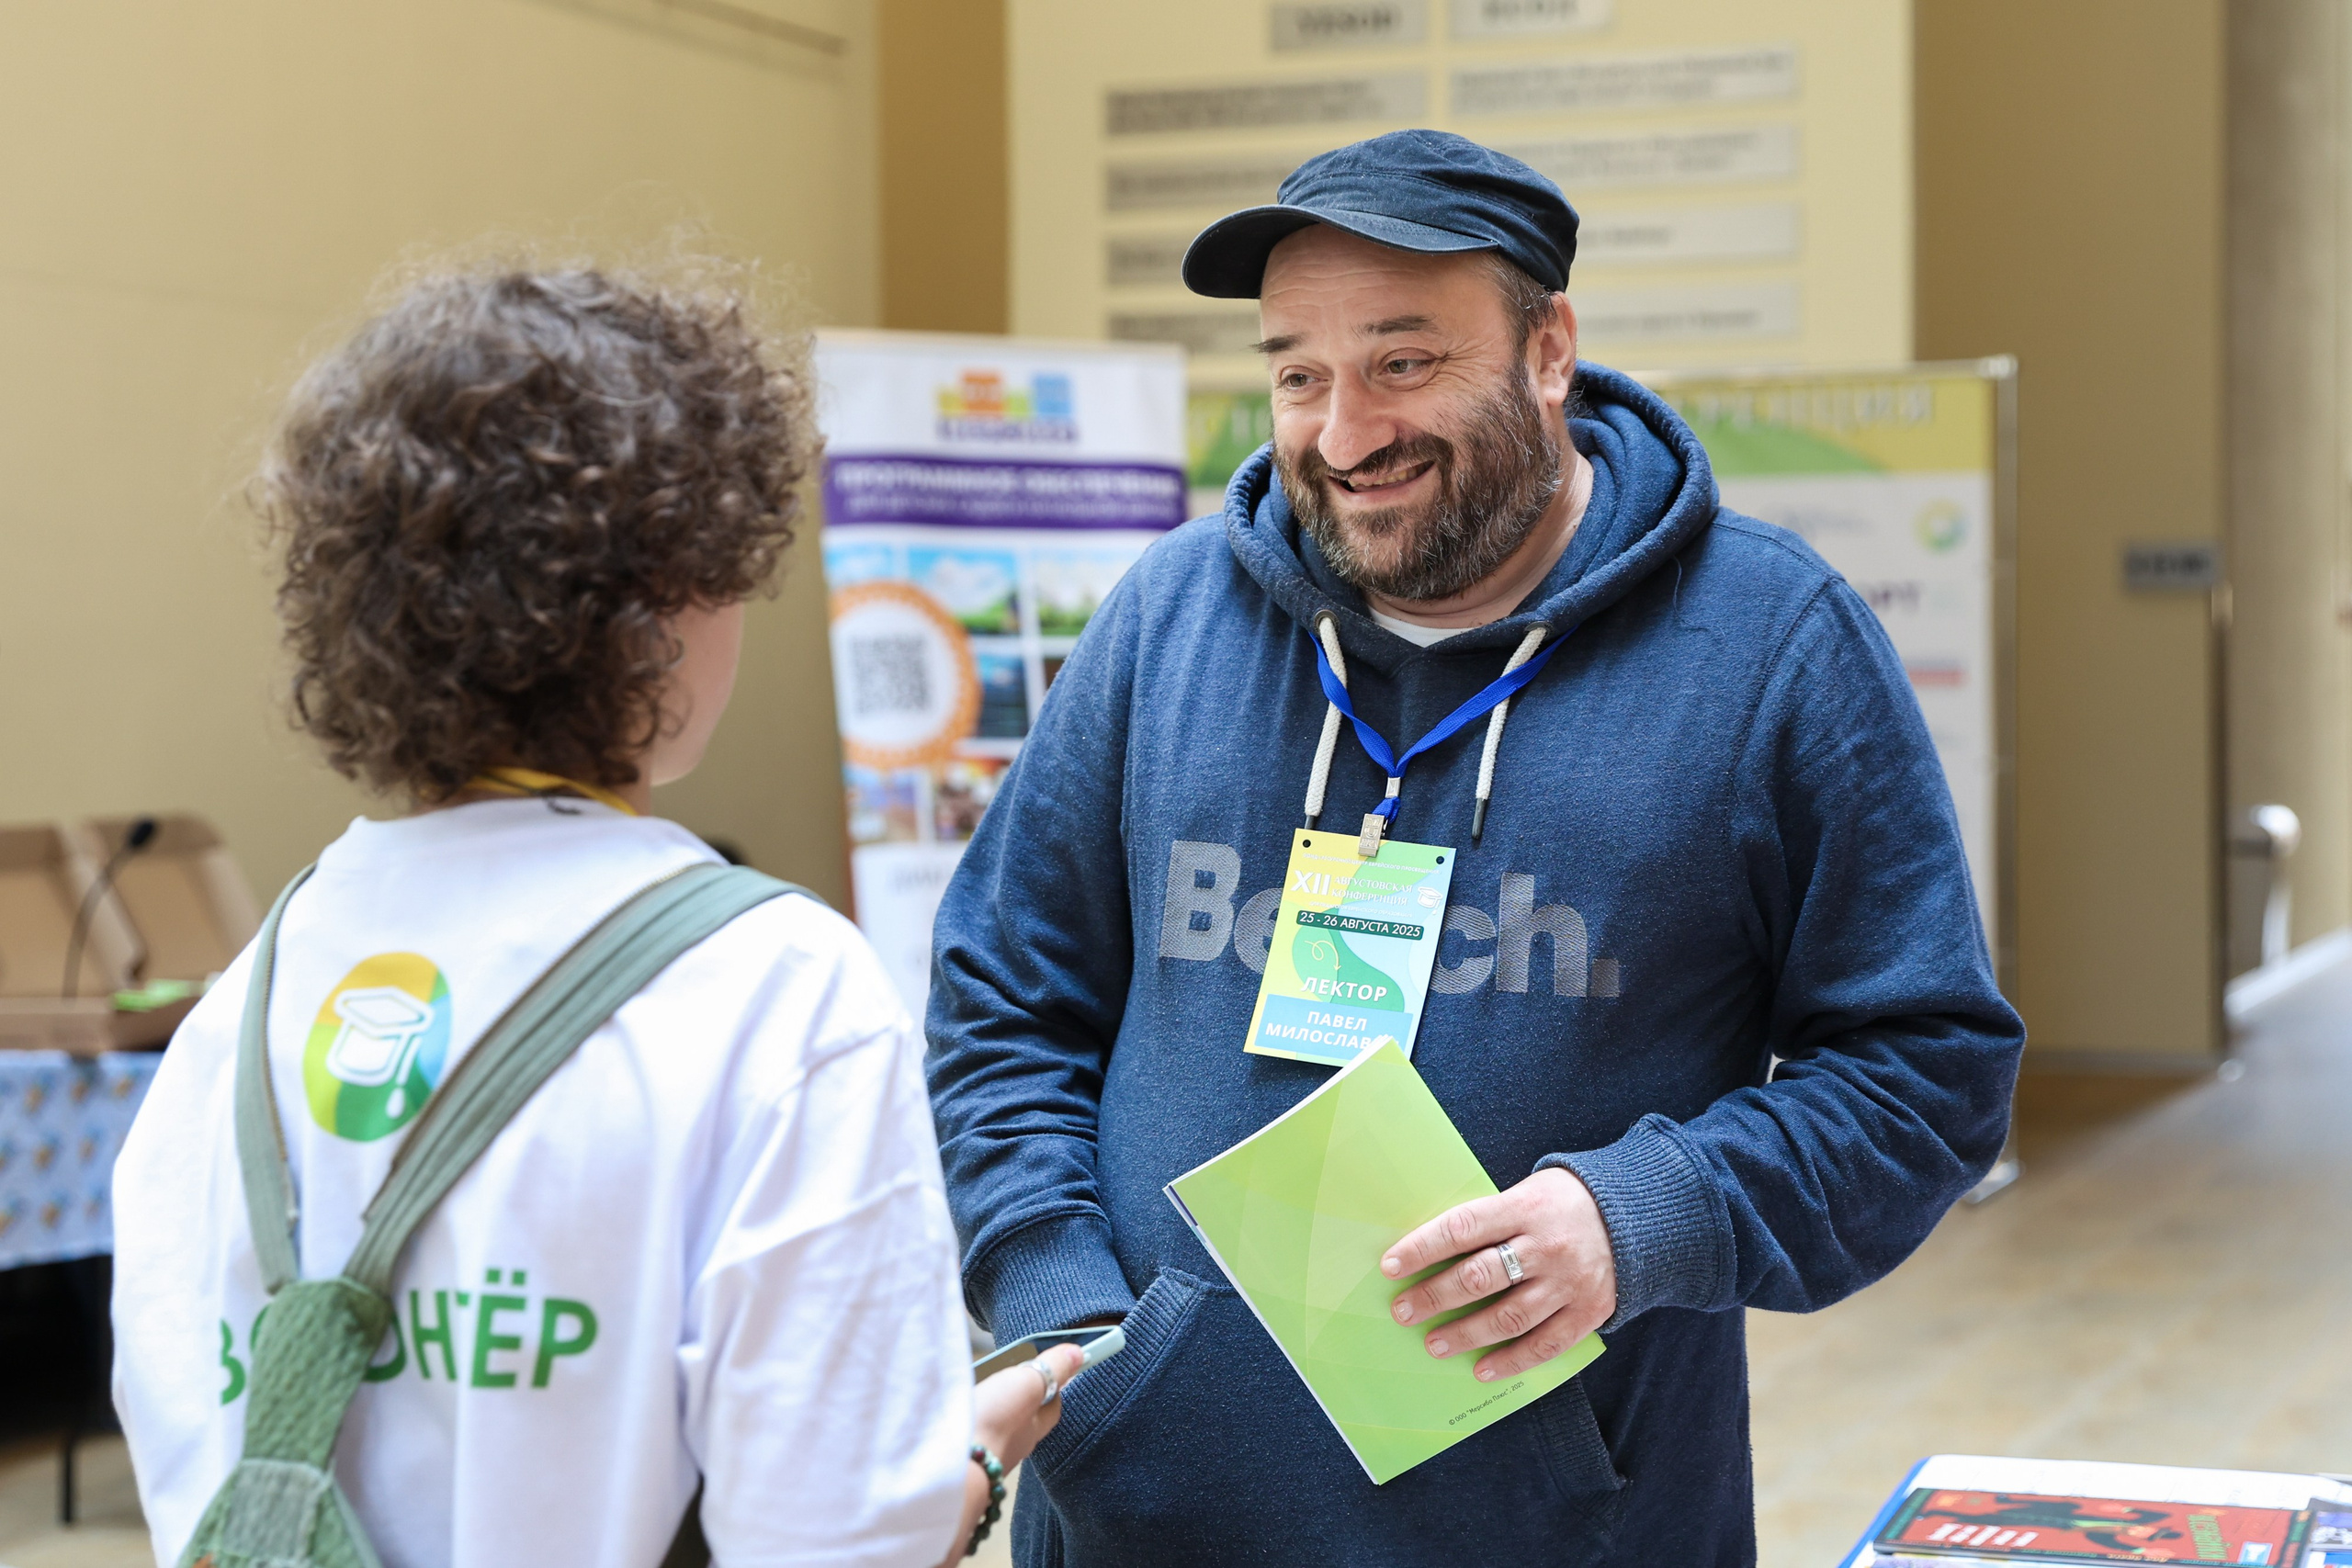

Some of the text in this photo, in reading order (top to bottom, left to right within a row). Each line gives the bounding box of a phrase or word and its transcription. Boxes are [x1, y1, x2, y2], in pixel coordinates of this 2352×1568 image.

[1291, 870, 1331, 896] XII
[1334, 875, 1413, 893] АВГУСТОВСКАЯ
[1331, 888, 1408, 906] КОНФЕРЕНЦИЯ
[1299, 912, 1315, 923] 25
[1323, 915, 1338, 927] 26
[1340, 917, 1390, 934] АВГУСТА
[1392, 923, 1421, 937] 2025
[1300, 976, 1387, 1002] ЛЕКТОР
[1306, 1010, 1368, 1032] ПАВЕЛ
[1265, 1022, 1399, 1051] МИЛОСЛАВ
[1511, 1380, 1525, 1392] 2025
